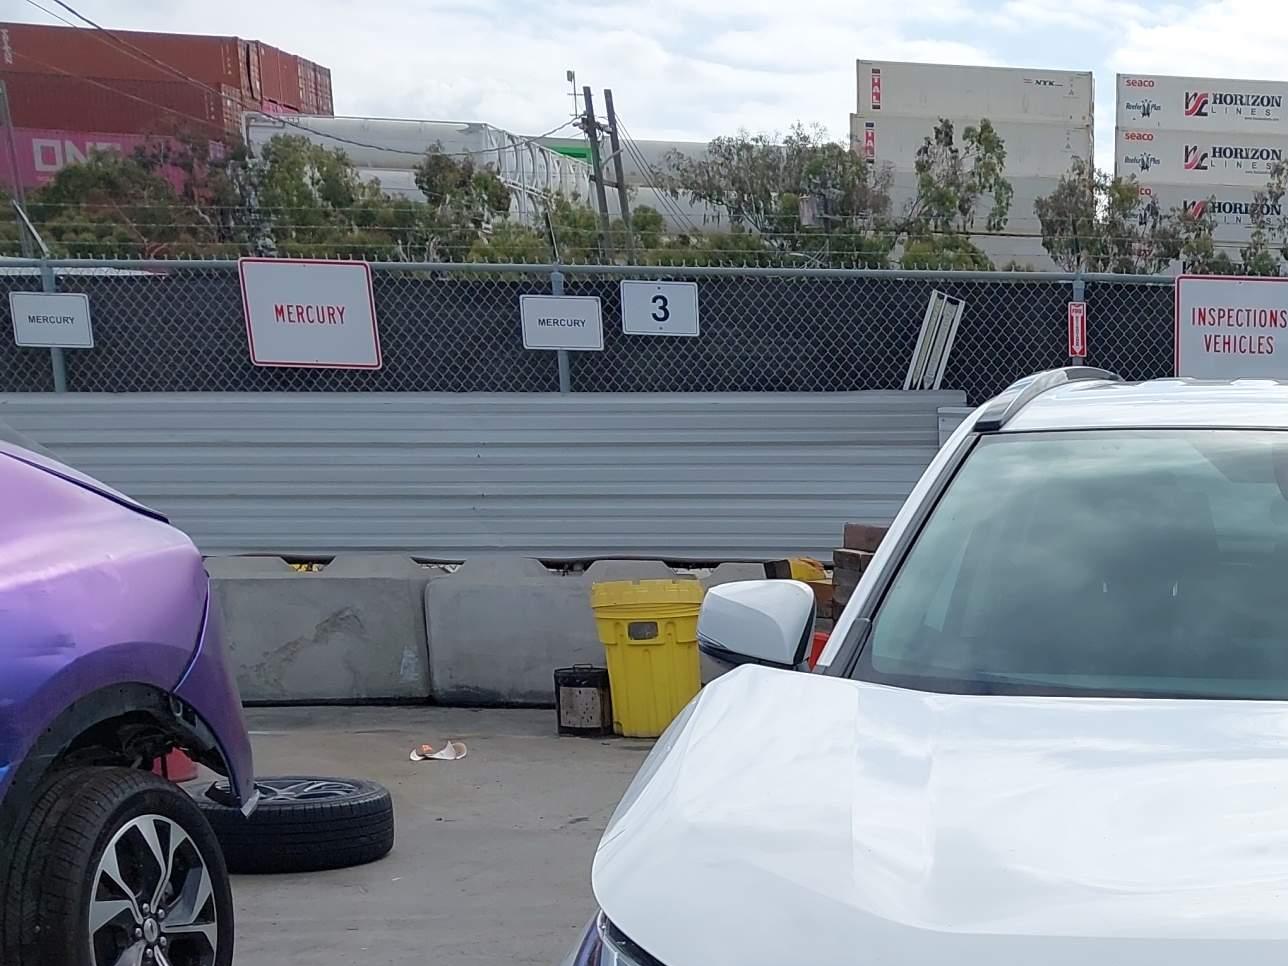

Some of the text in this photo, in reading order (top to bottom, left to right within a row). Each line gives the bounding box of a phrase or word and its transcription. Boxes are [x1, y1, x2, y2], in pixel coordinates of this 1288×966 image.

[1126, 79, 1155, 88] seaco
[1211, 93, 1283, 107] HORIZON
[1211, 107, 1272, 116] LINES
[1125, 132, 1154, 141] seaco
[32, 138, 121, 172] ON
[1211, 147, 1283, 161] HORIZON
[1211, 161, 1272, 169] LINES
[274, 303, 346, 325] MERCURY
[651, 295, 671, 322] 3
[28, 314, 75, 326] MERCURY
[538, 318, 586, 328] MERCURY
[1191, 307, 1288, 328] INSPECTIONS
[1204, 334, 1275, 354] VEHICLES
